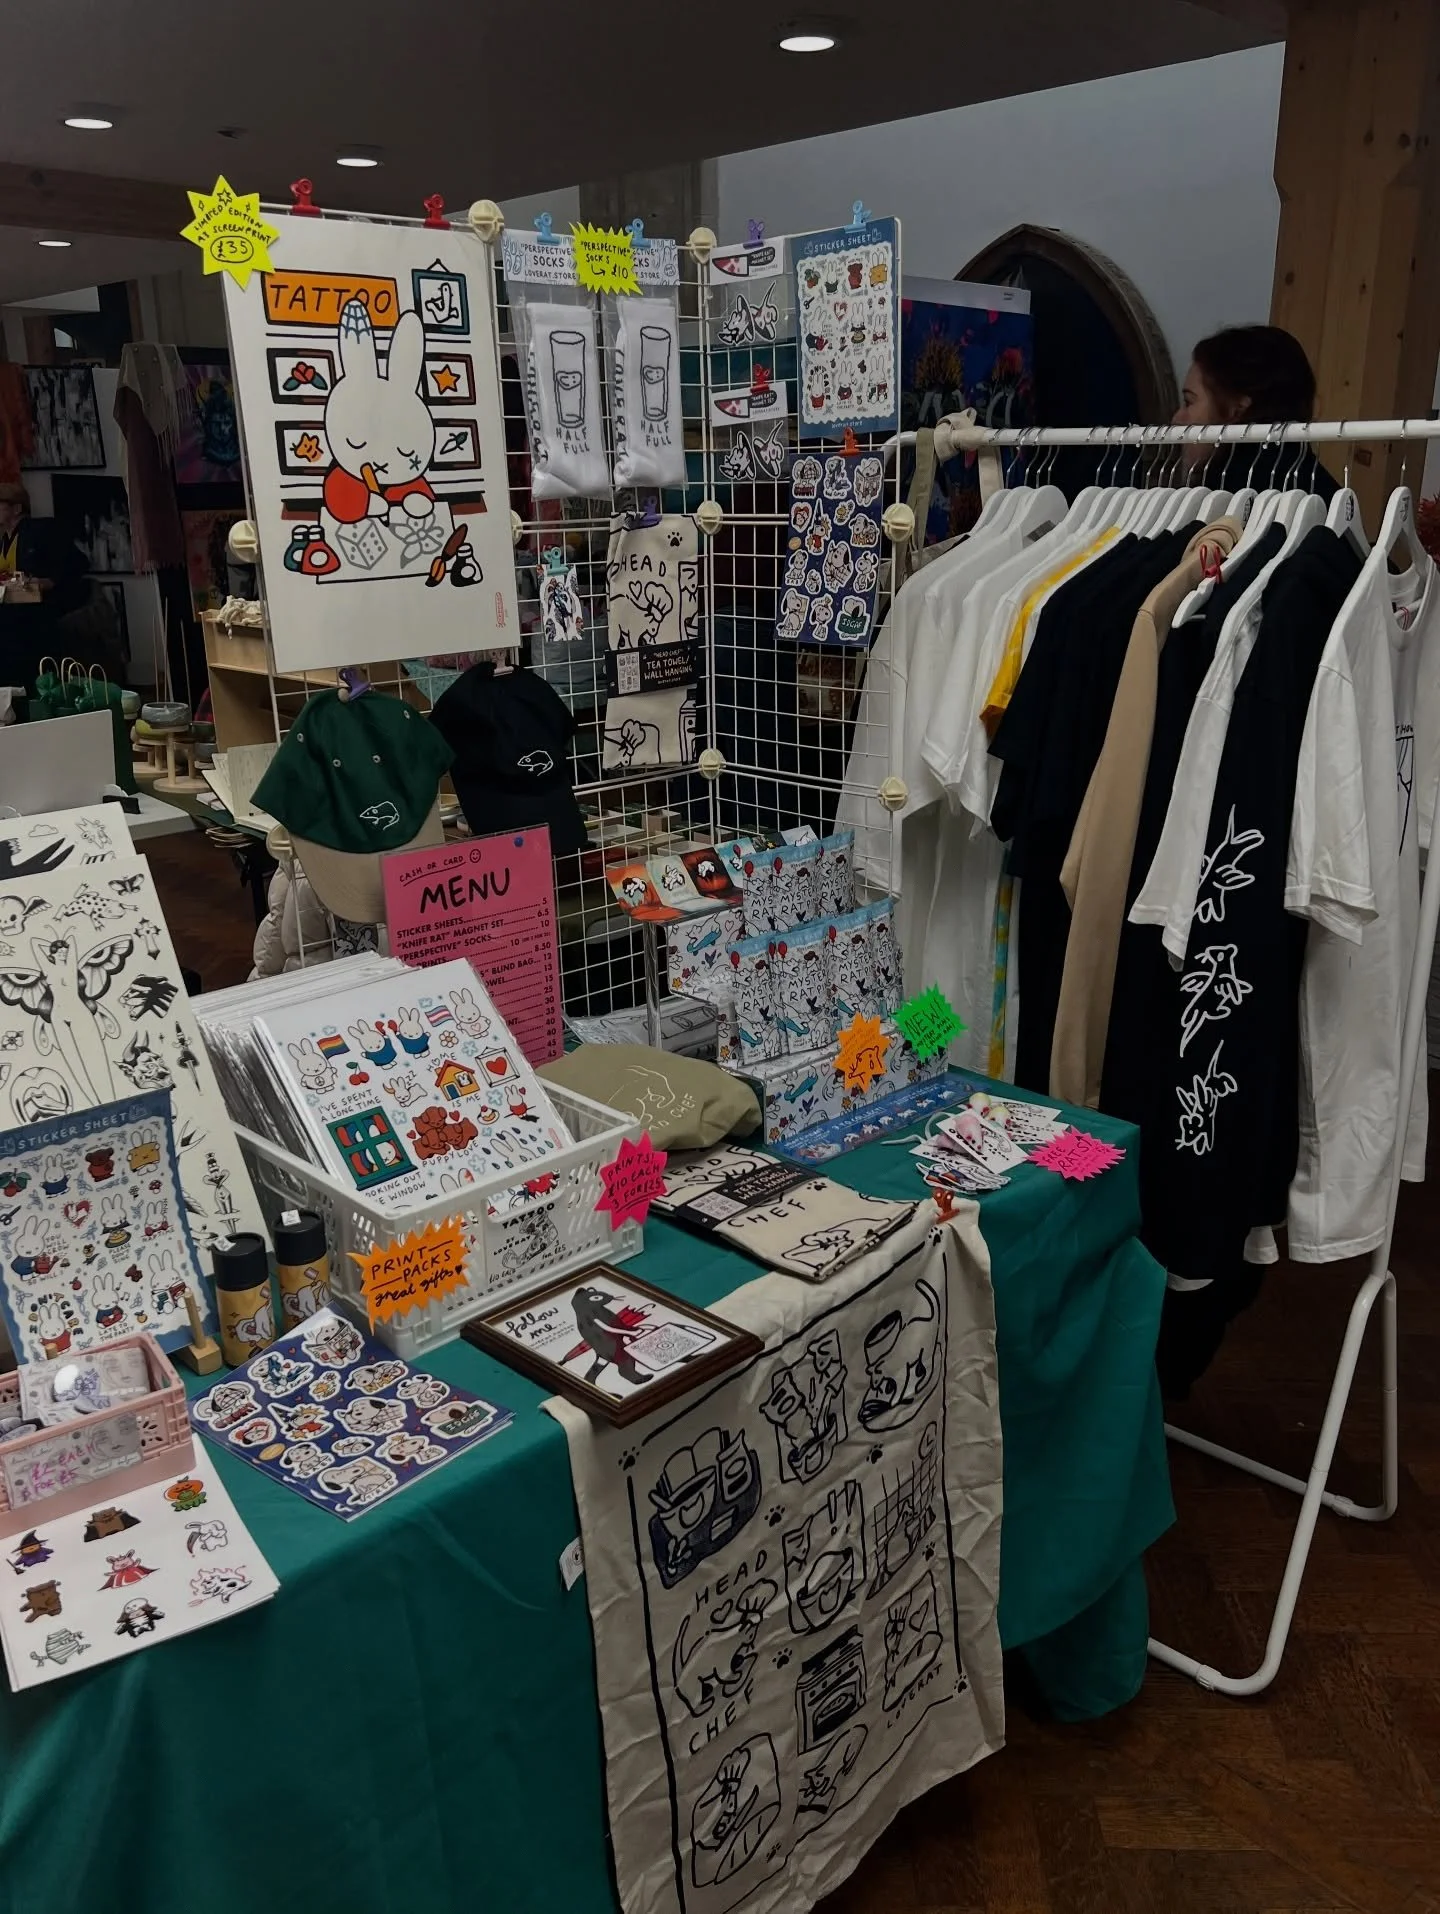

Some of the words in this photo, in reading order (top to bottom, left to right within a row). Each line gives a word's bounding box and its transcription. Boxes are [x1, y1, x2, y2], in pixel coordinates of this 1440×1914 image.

[229, 207, 263, 228] EDITION
[217, 241, 248, 257] £35
[814, 240, 845, 252] STICKER
[847, 234, 871, 243] SHEET
[533, 256, 565, 268] SOCKS
[586, 253, 610, 264] SOCKS
[611, 264, 629, 279] £10
[270, 285, 391, 314] TATTOO
[556, 427, 587, 441] HALF
[641, 420, 670, 433] HALF
[564, 443, 590, 454] FULL
[646, 435, 672, 446] FULL
[620, 554, 666, 577] HEAD
[644, 670, 665, 680] WALL
[665, 664, 693, 678] HANGING
[646, 661, 662, 670] TEA
[399, 866, 423, 883] CASH
[427, 860, 437, 869] OR
[443, 855, 464, 867] CARD
[420, 867, 510, 914] MENU
[821, 888, 841, 900] RAT
[752, 907, 777, 919] RAT
[781, 901, 803, 915] RAT
[397, 938, 428, 950] "KNIFE
[430, 932, 450, 943] RAT"
[453, 923, 489, 937] MAGNET
[537, 908, 549, 918] 6.5
[397, 924, 432, 938] STICKER
[540, 920, 550, 928] 10
[510, 939, 520, 947] 10
[534, 942, 551, 952] 8.50
[491, 963, 515, 975] BLIND
[841, 969, 862, 984] RAT
[486, 976, 506, 988] WEL
[544, 975, 553, 983] 15
[544, 986, 553, 994] 25
[790, 987, 813, 1001] RAT
[544, 996, 554, 1004] 30
[743, 996, 766, 1012] RAT
[545, 1007, 555, 1015] 35
[904, 997, 944, 1040] NEW!
[427, 1052, 457, 1072] HOME
[318, 1102, 338, 1114] I'VE
[341, 1089, 372, 1105] SPENT
[466, 1094, 480, 1103] ME
[670, 1093, 695, 1118] CHEF
[331, 1107, 354, 1120] LONG
[356, 1098, 381, 1110] TIME
[18, 1125, 78, 1150] STICKER
[84, 1112, 128, 1132] SHEET
[422, 1153, 454, 1167] PUPPY
[458, 1140, 479, 1158] LOVE
[1042, 1145, 1066, 1164] FREE
[607, 1153, 655, 1179] PRINTS!
[365, 1181, 400, 1198] OKING
[403, 1172, 422, 1184] OUT
[608, 1178, 628, 1198] £10
[631, 1164, 660, 1181] EACH
[387, 1181, 426, 1201] WINDOW
[612, 1199, 620, 1209] 3
[623, 1184, 642, 1201] FOR
[502, 1202, 555, 1229] TATTOO
[727, 1198, 805, 1228] CHEF
[372, 1246, 427, 1280] PRINT
[403, 1249, 451, 1282] PACKS
[375, 1283, 416, 1307] great
[420, 1268, 453, 1292] gifts
[99, 1326, 117, 1336] LATE
[506, 1307, 558, 1338] follow
[695, 1550, 768, 1612] HEAD
[690, 1678, 755, 1755] CHEF
